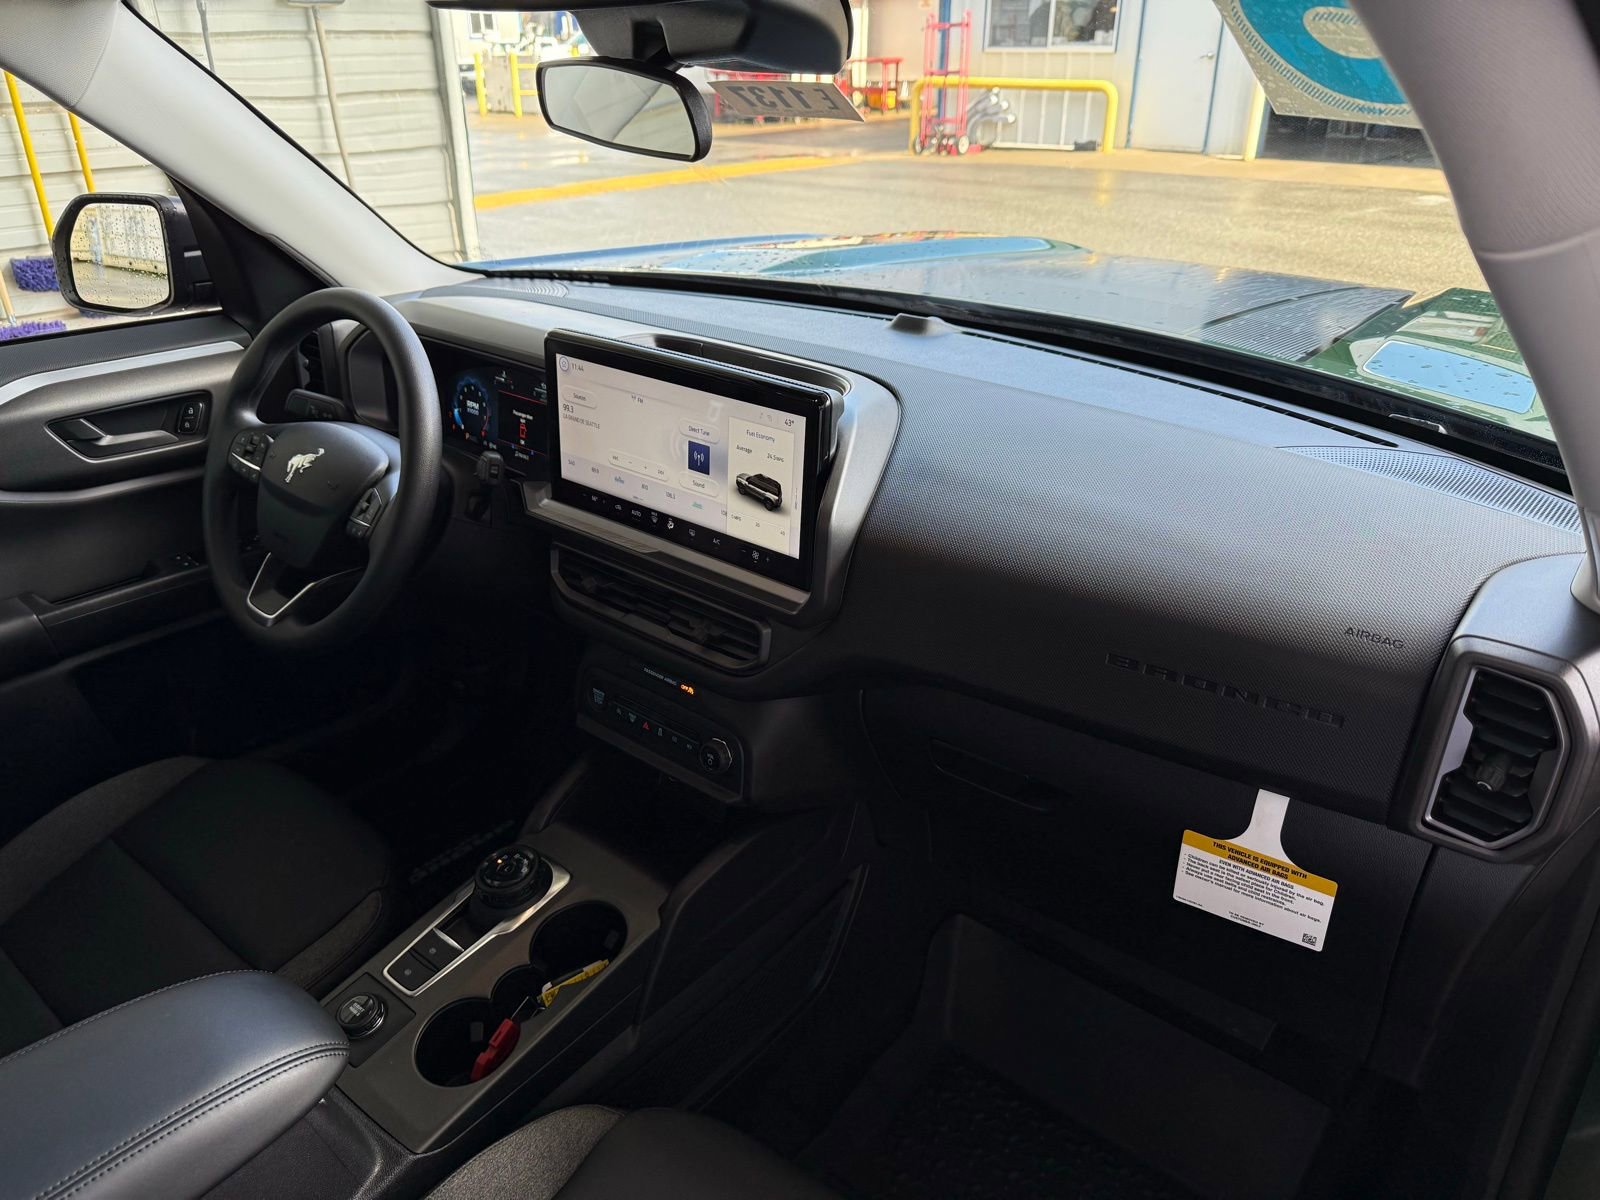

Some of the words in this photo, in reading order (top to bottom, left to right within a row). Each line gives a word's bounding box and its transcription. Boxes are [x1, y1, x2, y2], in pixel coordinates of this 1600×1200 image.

[466, 400, 480, 409] RPM
[562, 403, 574, 413] 99.3
[688, 425, 700, 434] Direct
[701, 428, 710, 436] Tune
[784, 418, 795, 427] 43°
[746, 429, 756, 439] Fuel
[756, 431, 776, 444] Economy
[735, 444, 753, 454] Average
[693, 480, 705, 489] Sound
[631, 509, 641, 518] AUTO
[1345, 627, 1404, 649] AIRBAG
[1105, 652, 1345, 728] BRONCO
[1212, 841, 1226, 850] THIS
[1227, 846, 1251, 859] VEHICLE
[1260, 858, 1289, 873] EQUIPPED
[1290, 868, 1307, 879] WITH
[1227, 853, 1258, 868] ADVANCED
[1260, 865, 1270, 873] AIR
[1272, 869, 1288, 879] BAGS
[1185, 866, 1202, 876] Always
[1224, 880, 1236, 888] belts
[1186, 862, 1200, 870] Never
[1224, 876, 1240, 885] facing
[1188, 853, 1208, 864] Children
[1226, 867, 1239, 875] killed
[1246, 875, 1268, 886] seriously
[1269, 883, 1288, 893] injured
[1197, 861, 1208, 869] back
[1235, 875, 1249, 883] safest
[1250, 881, 1264, 889] place
[1218, 859, 1231, 867] EVEN
[1232, 864, 1244, 872] WITH
[1245, 868, 1270, 881] ADVANCED
[1280, 881, 1294, 889] BAGS
[1214, 881, 1232, 891] manual
[1254, 896, 1282, 908] information
[1284, 906, 1298, 915] about
